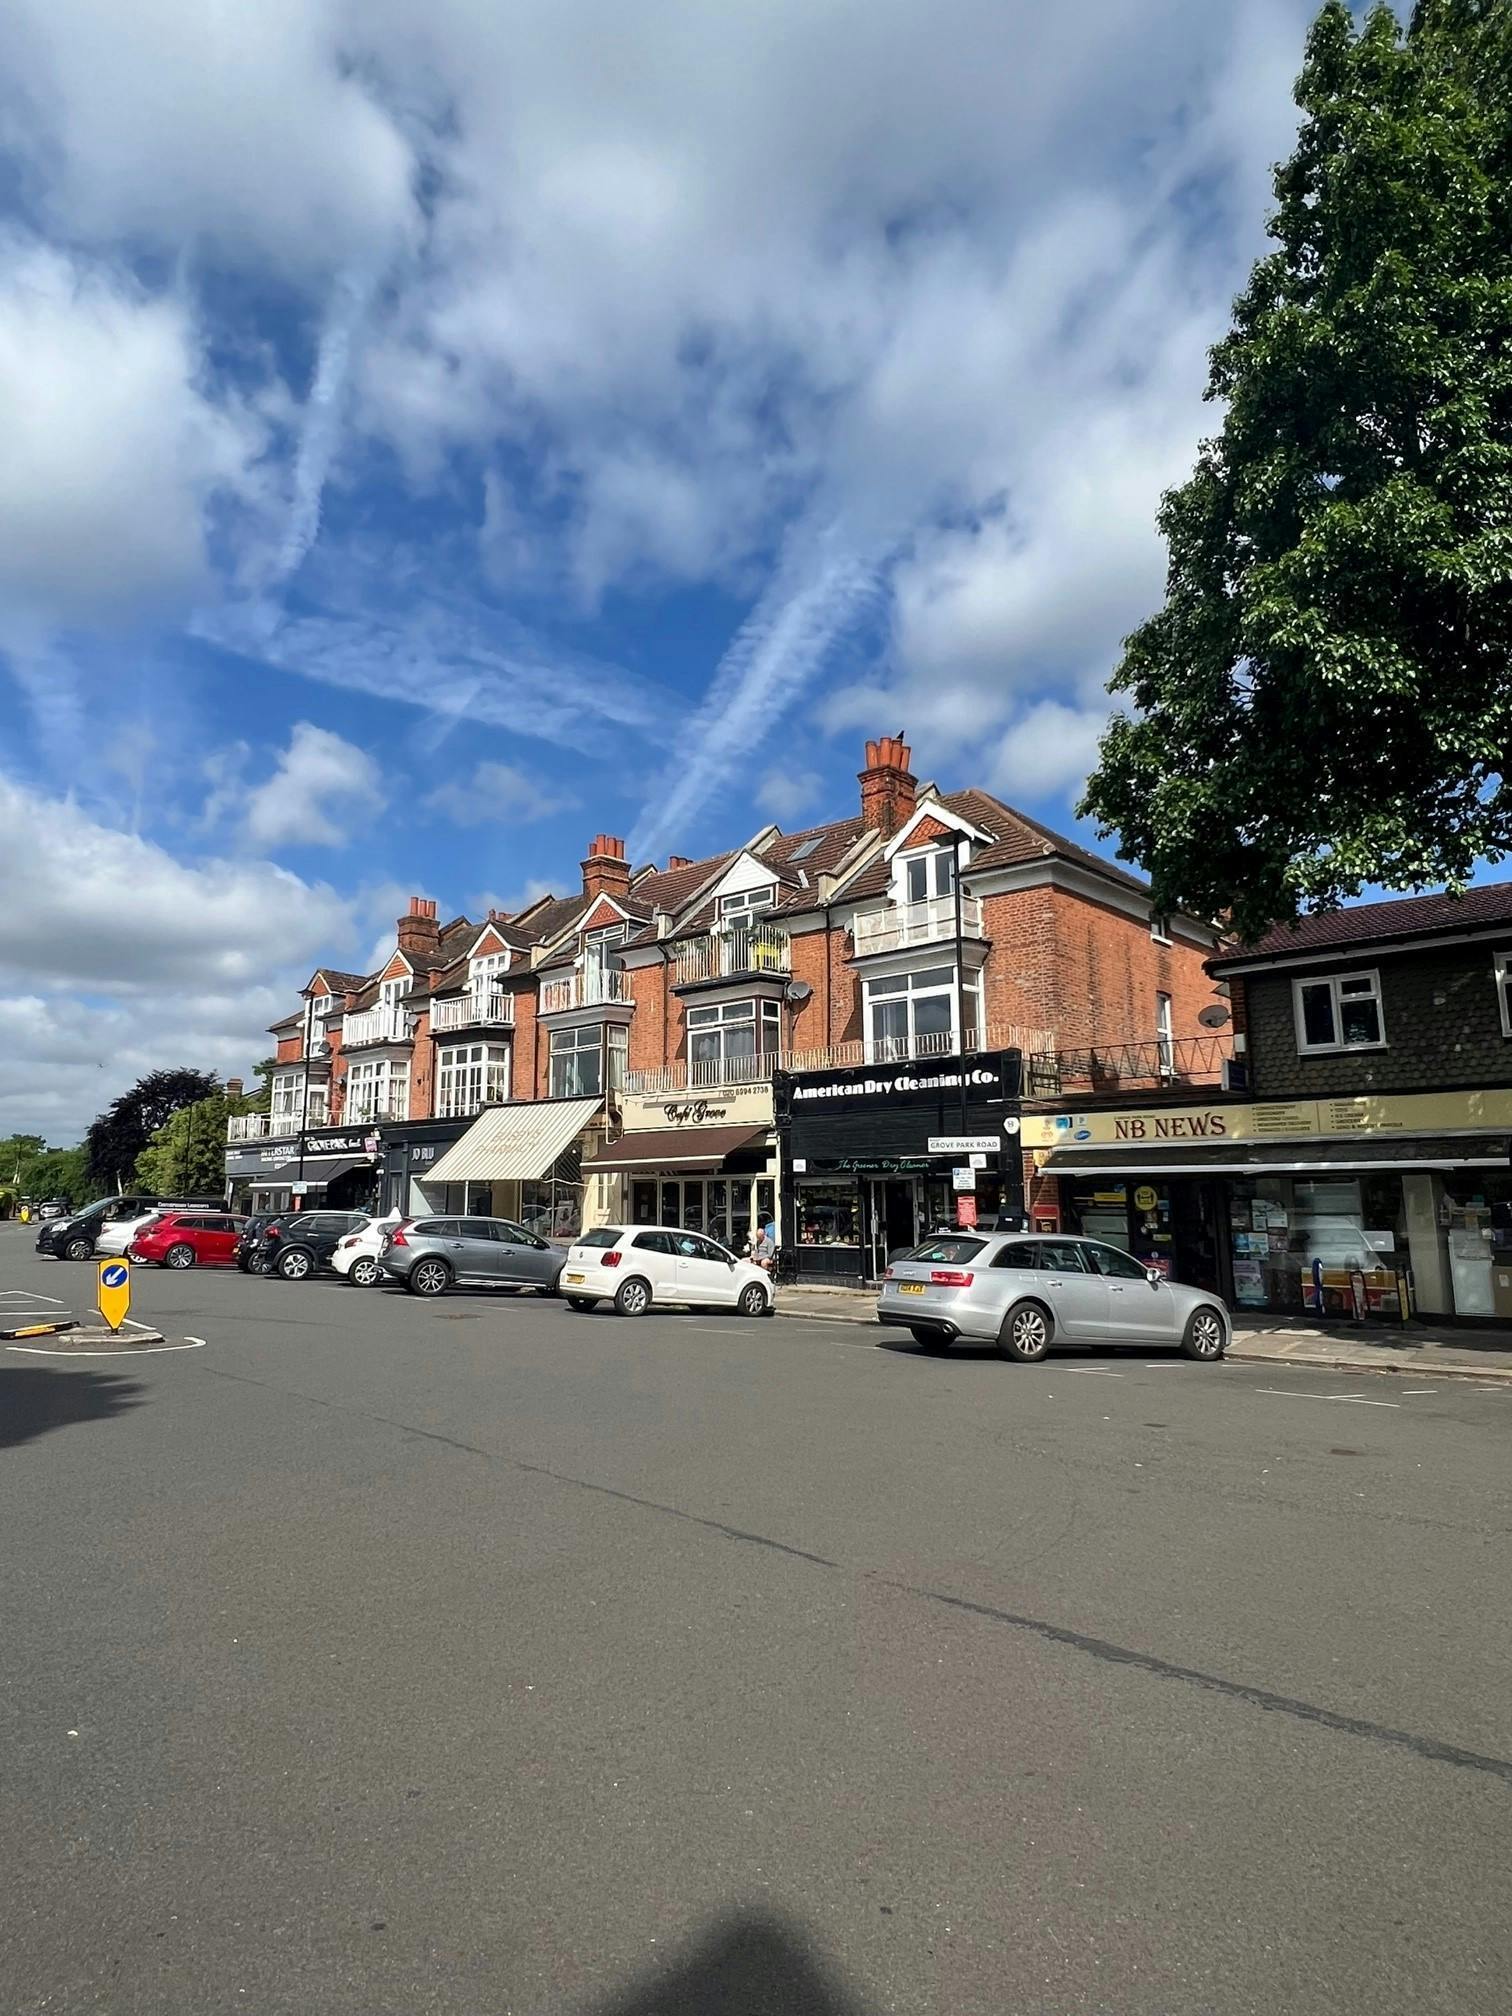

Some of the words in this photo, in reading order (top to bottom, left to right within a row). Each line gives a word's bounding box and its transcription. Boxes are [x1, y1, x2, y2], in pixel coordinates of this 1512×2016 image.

[793, 1082, 864, 1099] American
[864, 1080, 892, 1094] Dry
[894, 1073, 971, 1091] Cleaning
[971, 1069, 999, 1084] Co.
[692, 1100, 727, 1124] Grove
[1115, 1119, 1146, 1140] NB
[1154, 1112, 1226, 1138] NEWS
